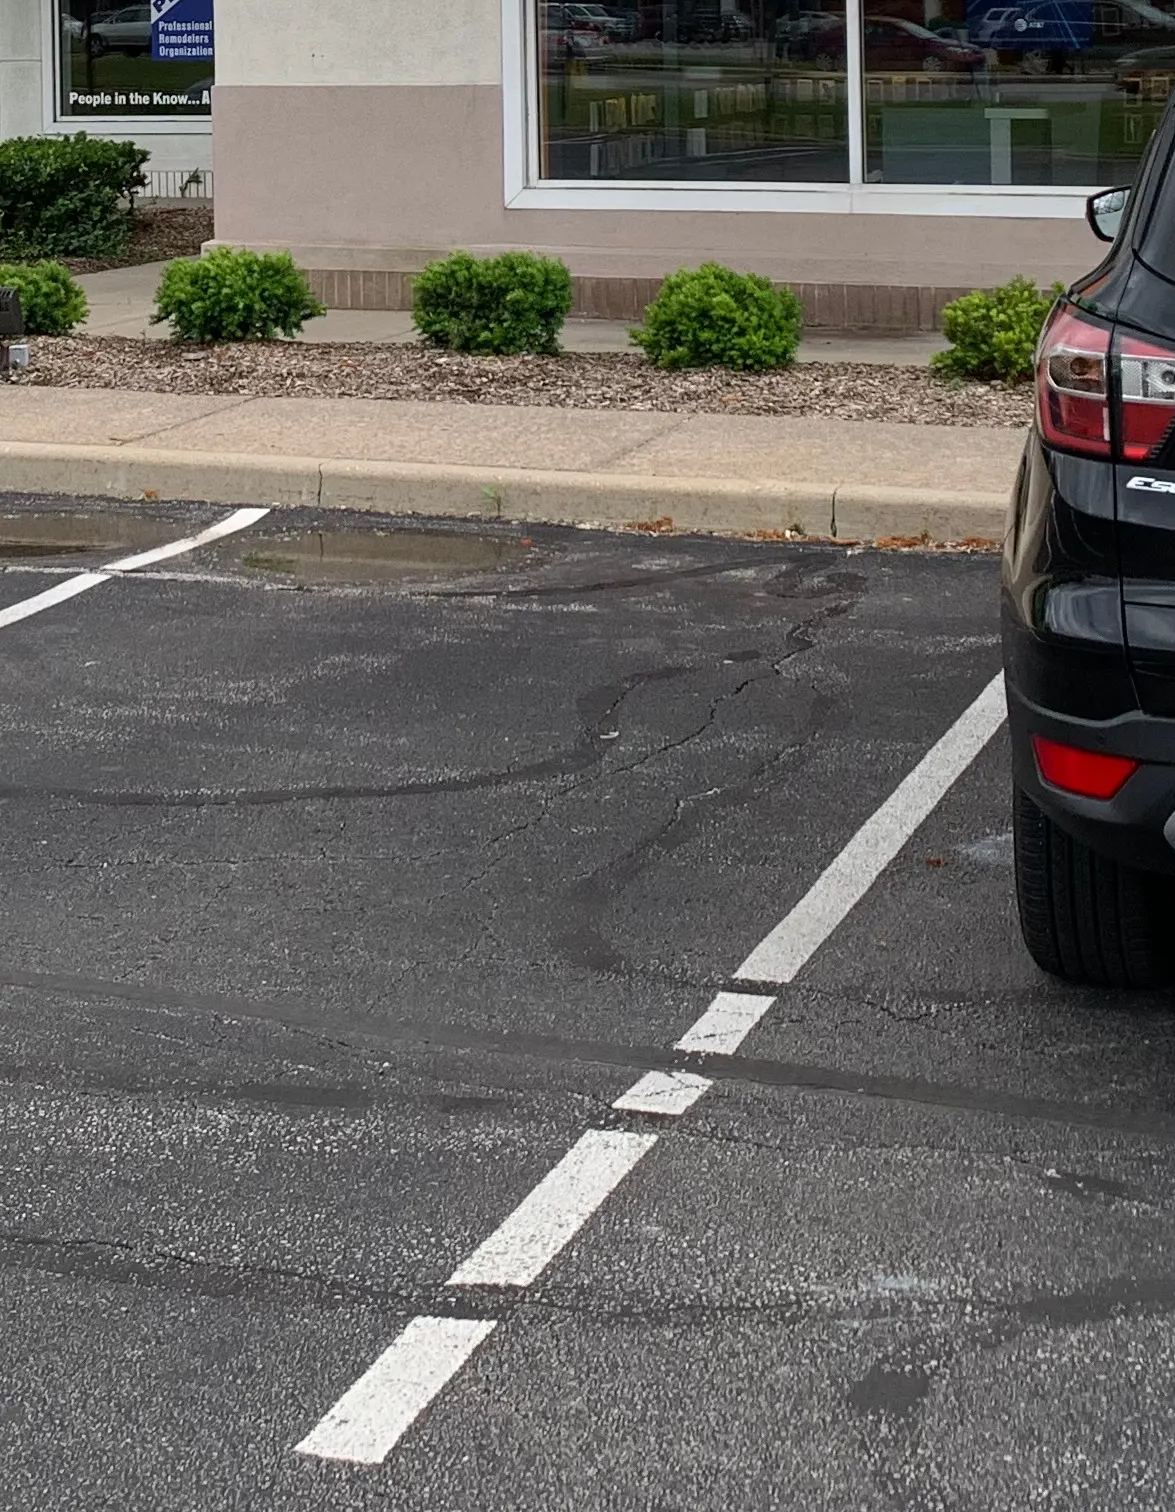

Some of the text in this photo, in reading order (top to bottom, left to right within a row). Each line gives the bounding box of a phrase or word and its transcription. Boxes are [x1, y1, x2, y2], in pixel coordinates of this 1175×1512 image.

[158, 20, 213, 31] Professional
[158, 33, 209, 44] Remodelers
[159, 46, 213, 58] Organization
[69, 92, 111, 107] People
[114, 92, 126, 104] in
[129, 92, 150, 104] the
[153, 92, 200, 105] Know...
